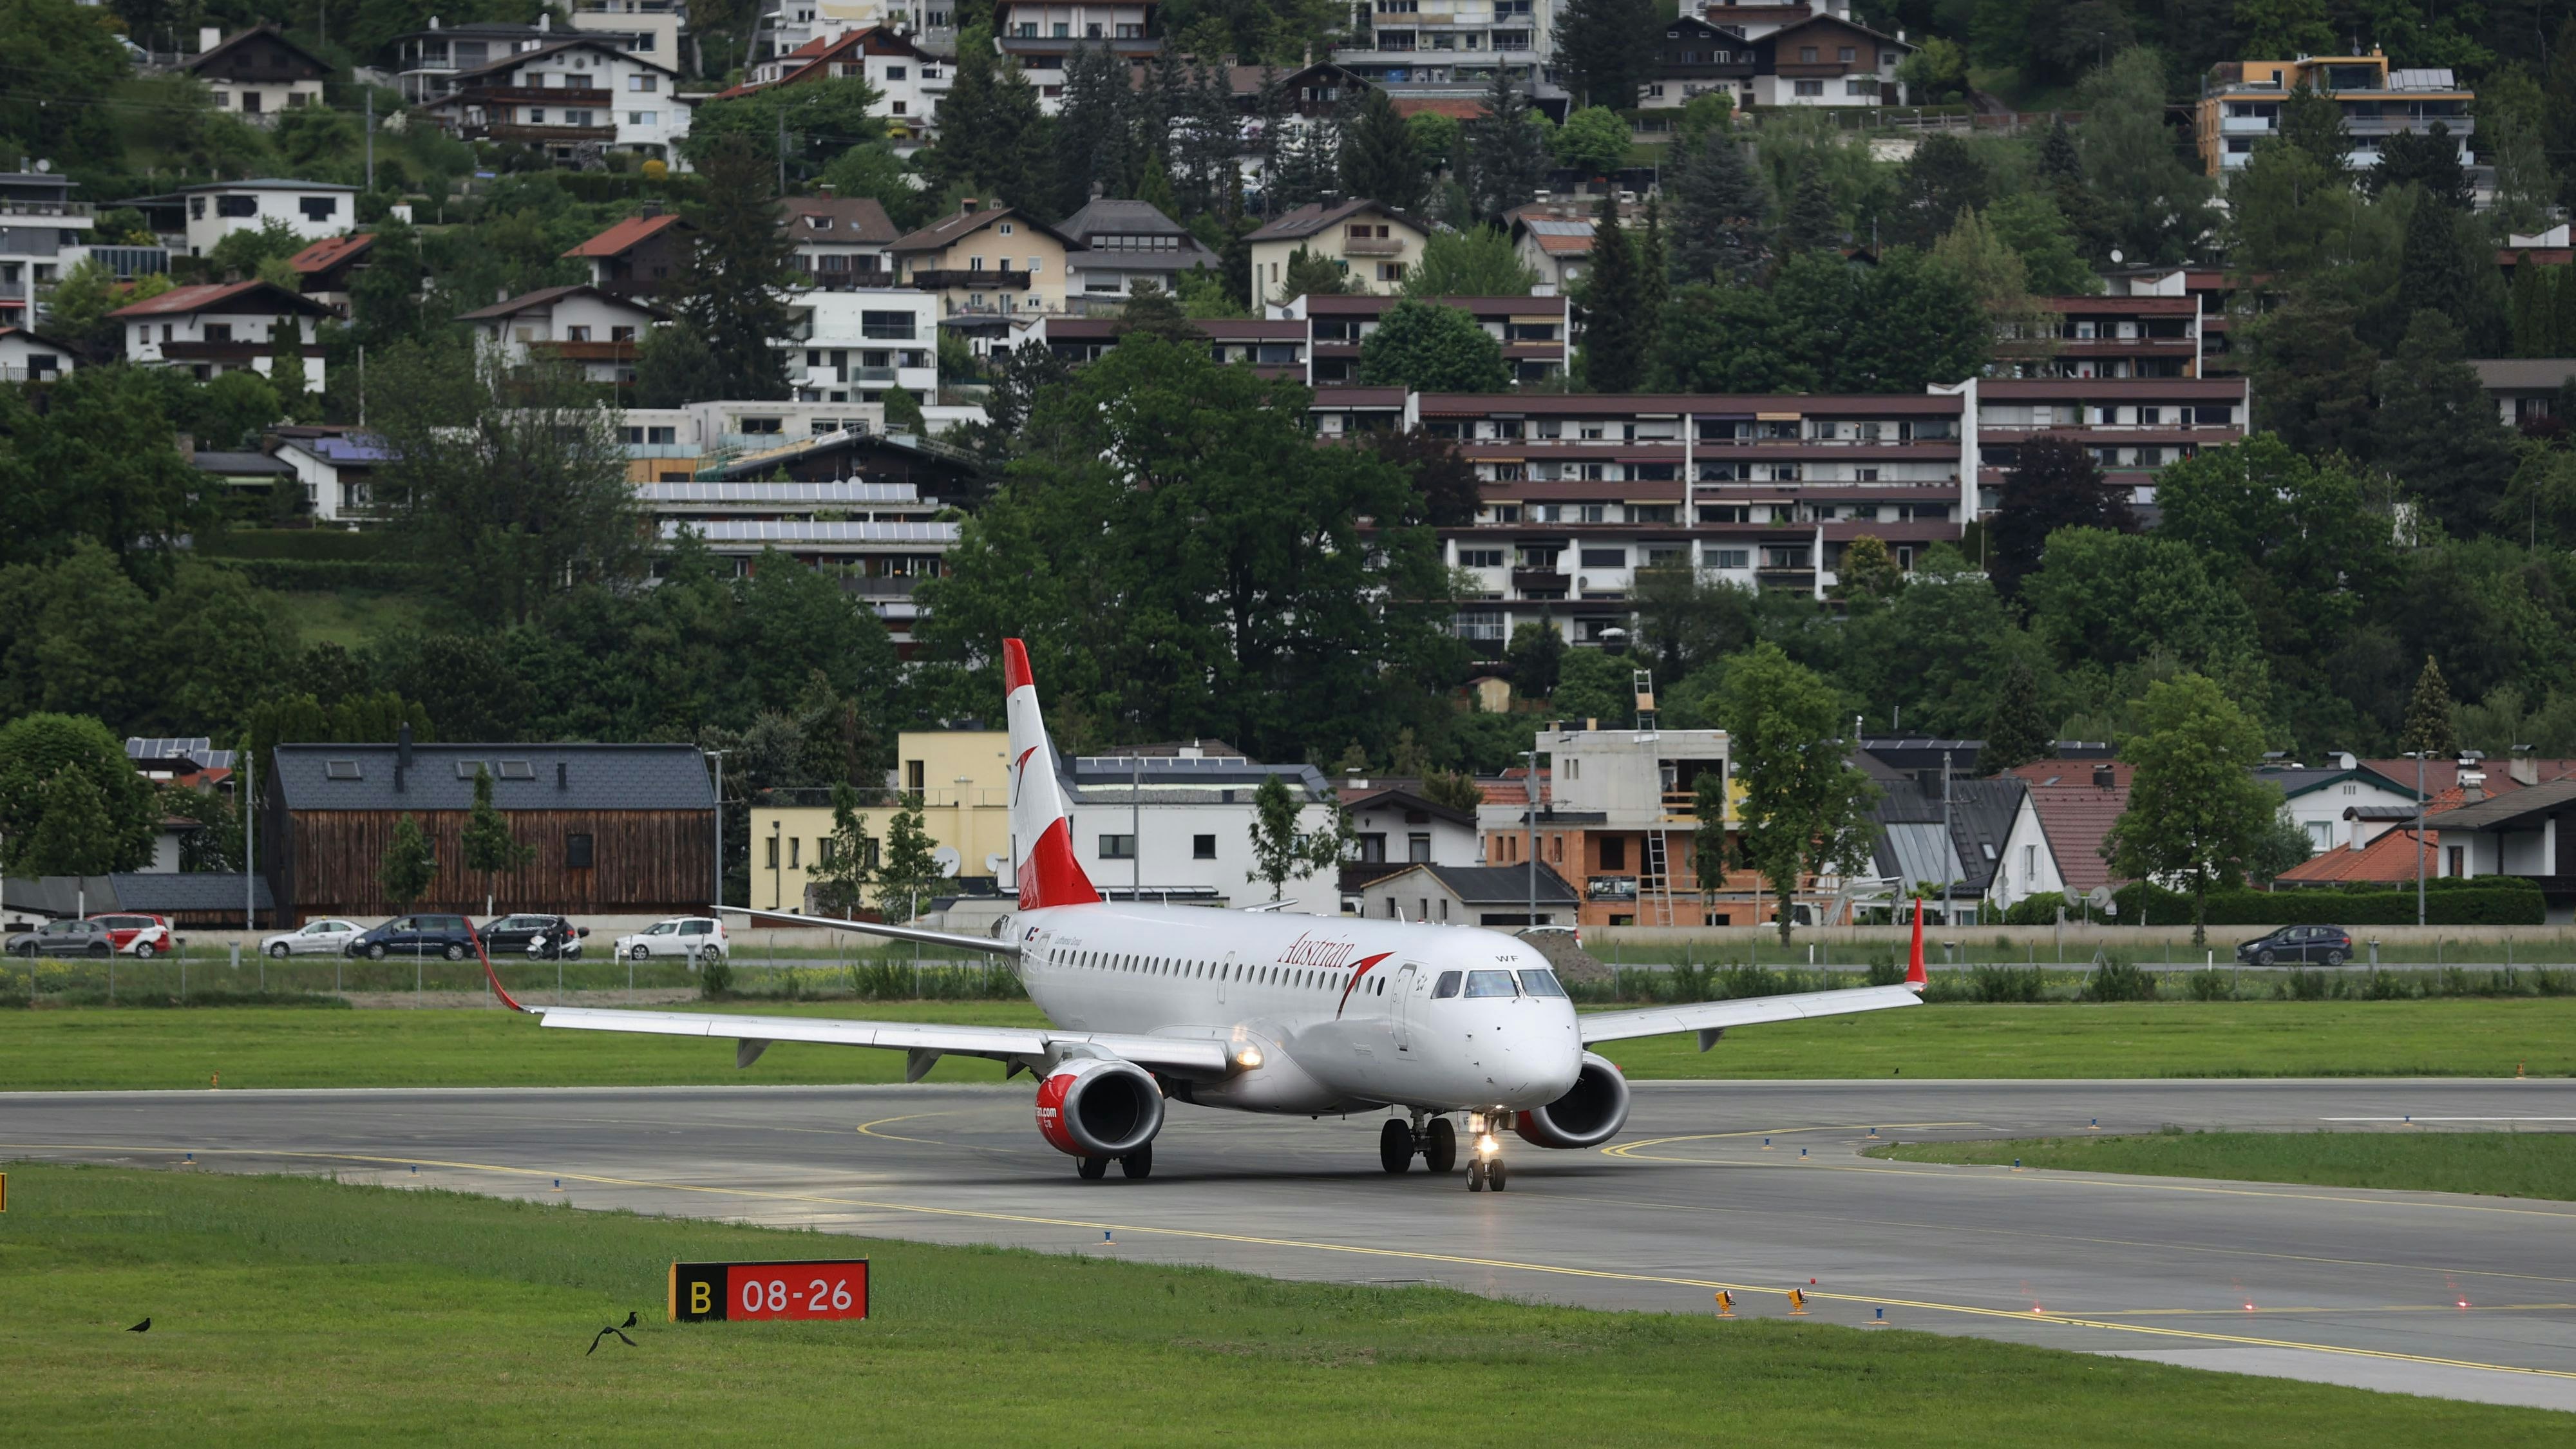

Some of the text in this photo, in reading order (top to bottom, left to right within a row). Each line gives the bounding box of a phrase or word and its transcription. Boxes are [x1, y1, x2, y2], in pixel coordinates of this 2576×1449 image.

[1276, 929, 1354, 968] Austrian
[691, 1279, 852, 1314] B 08-26
